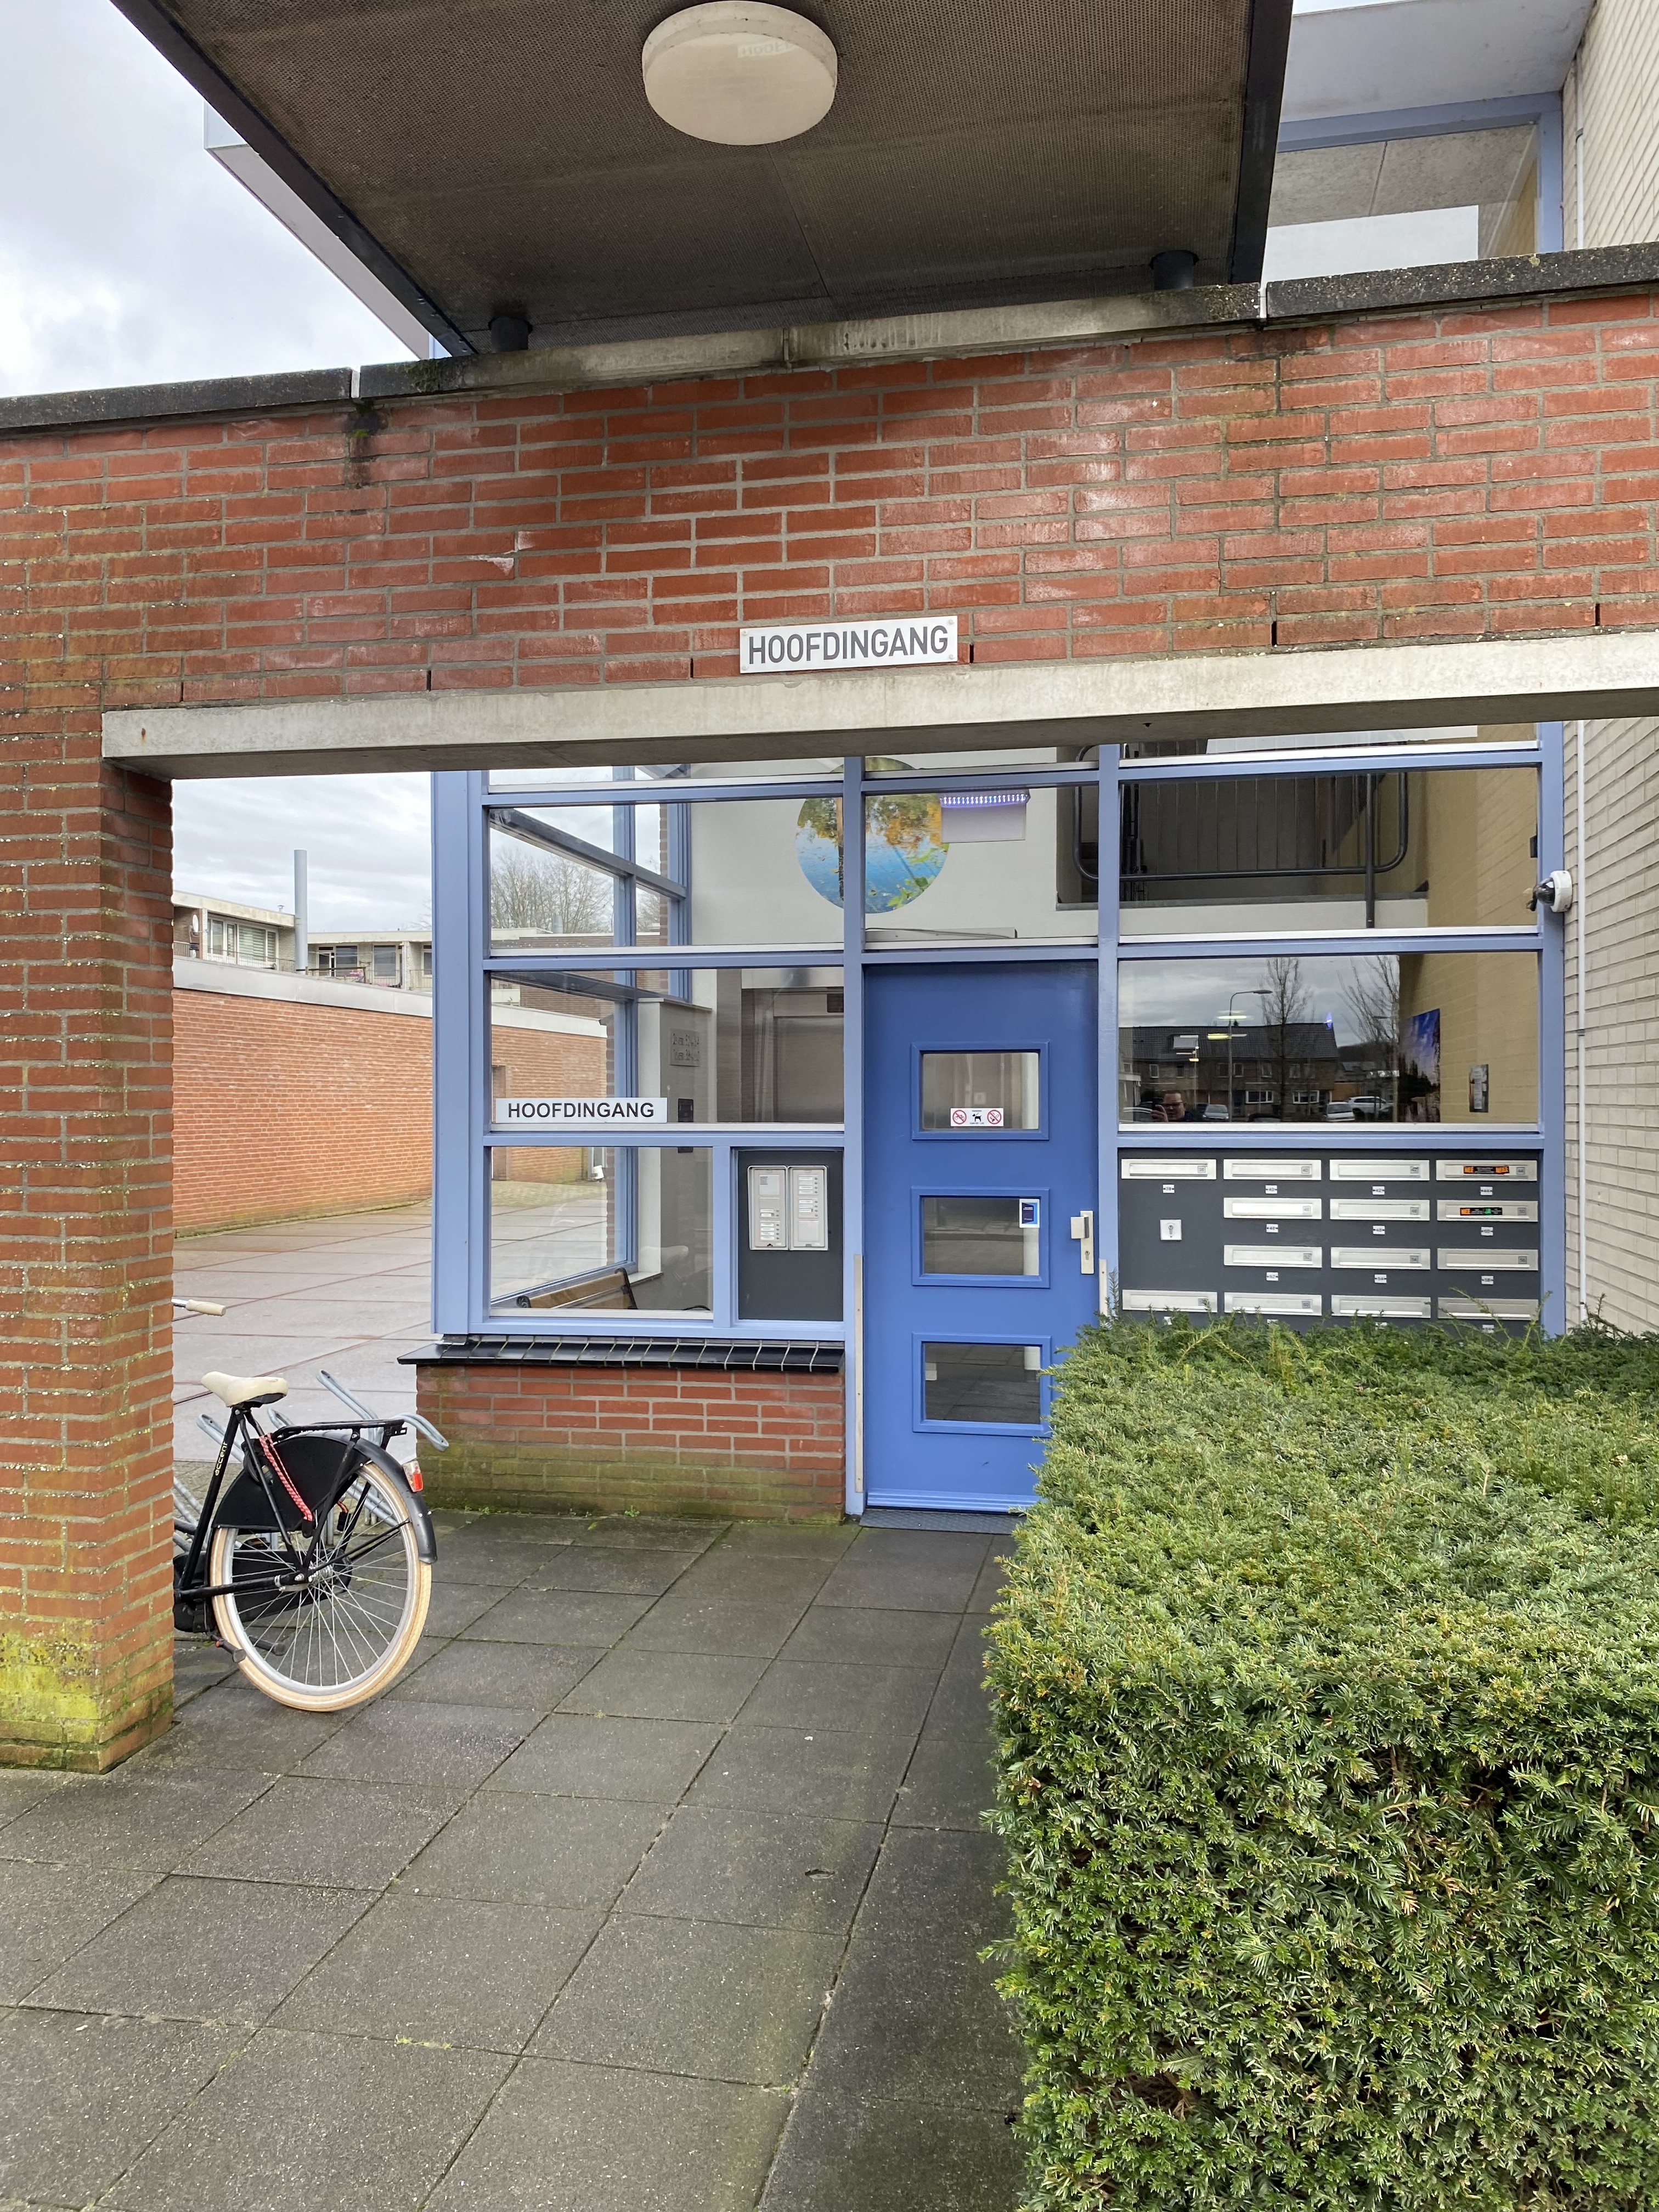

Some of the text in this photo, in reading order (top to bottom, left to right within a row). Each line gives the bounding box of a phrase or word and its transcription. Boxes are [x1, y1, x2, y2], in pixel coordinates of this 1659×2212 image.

[749, 625, 948, 664] HOOFDINGANG
[508, 1102, 654, 1118] HOOFDINGANG
[215, 1441, 228, 1476] accent
